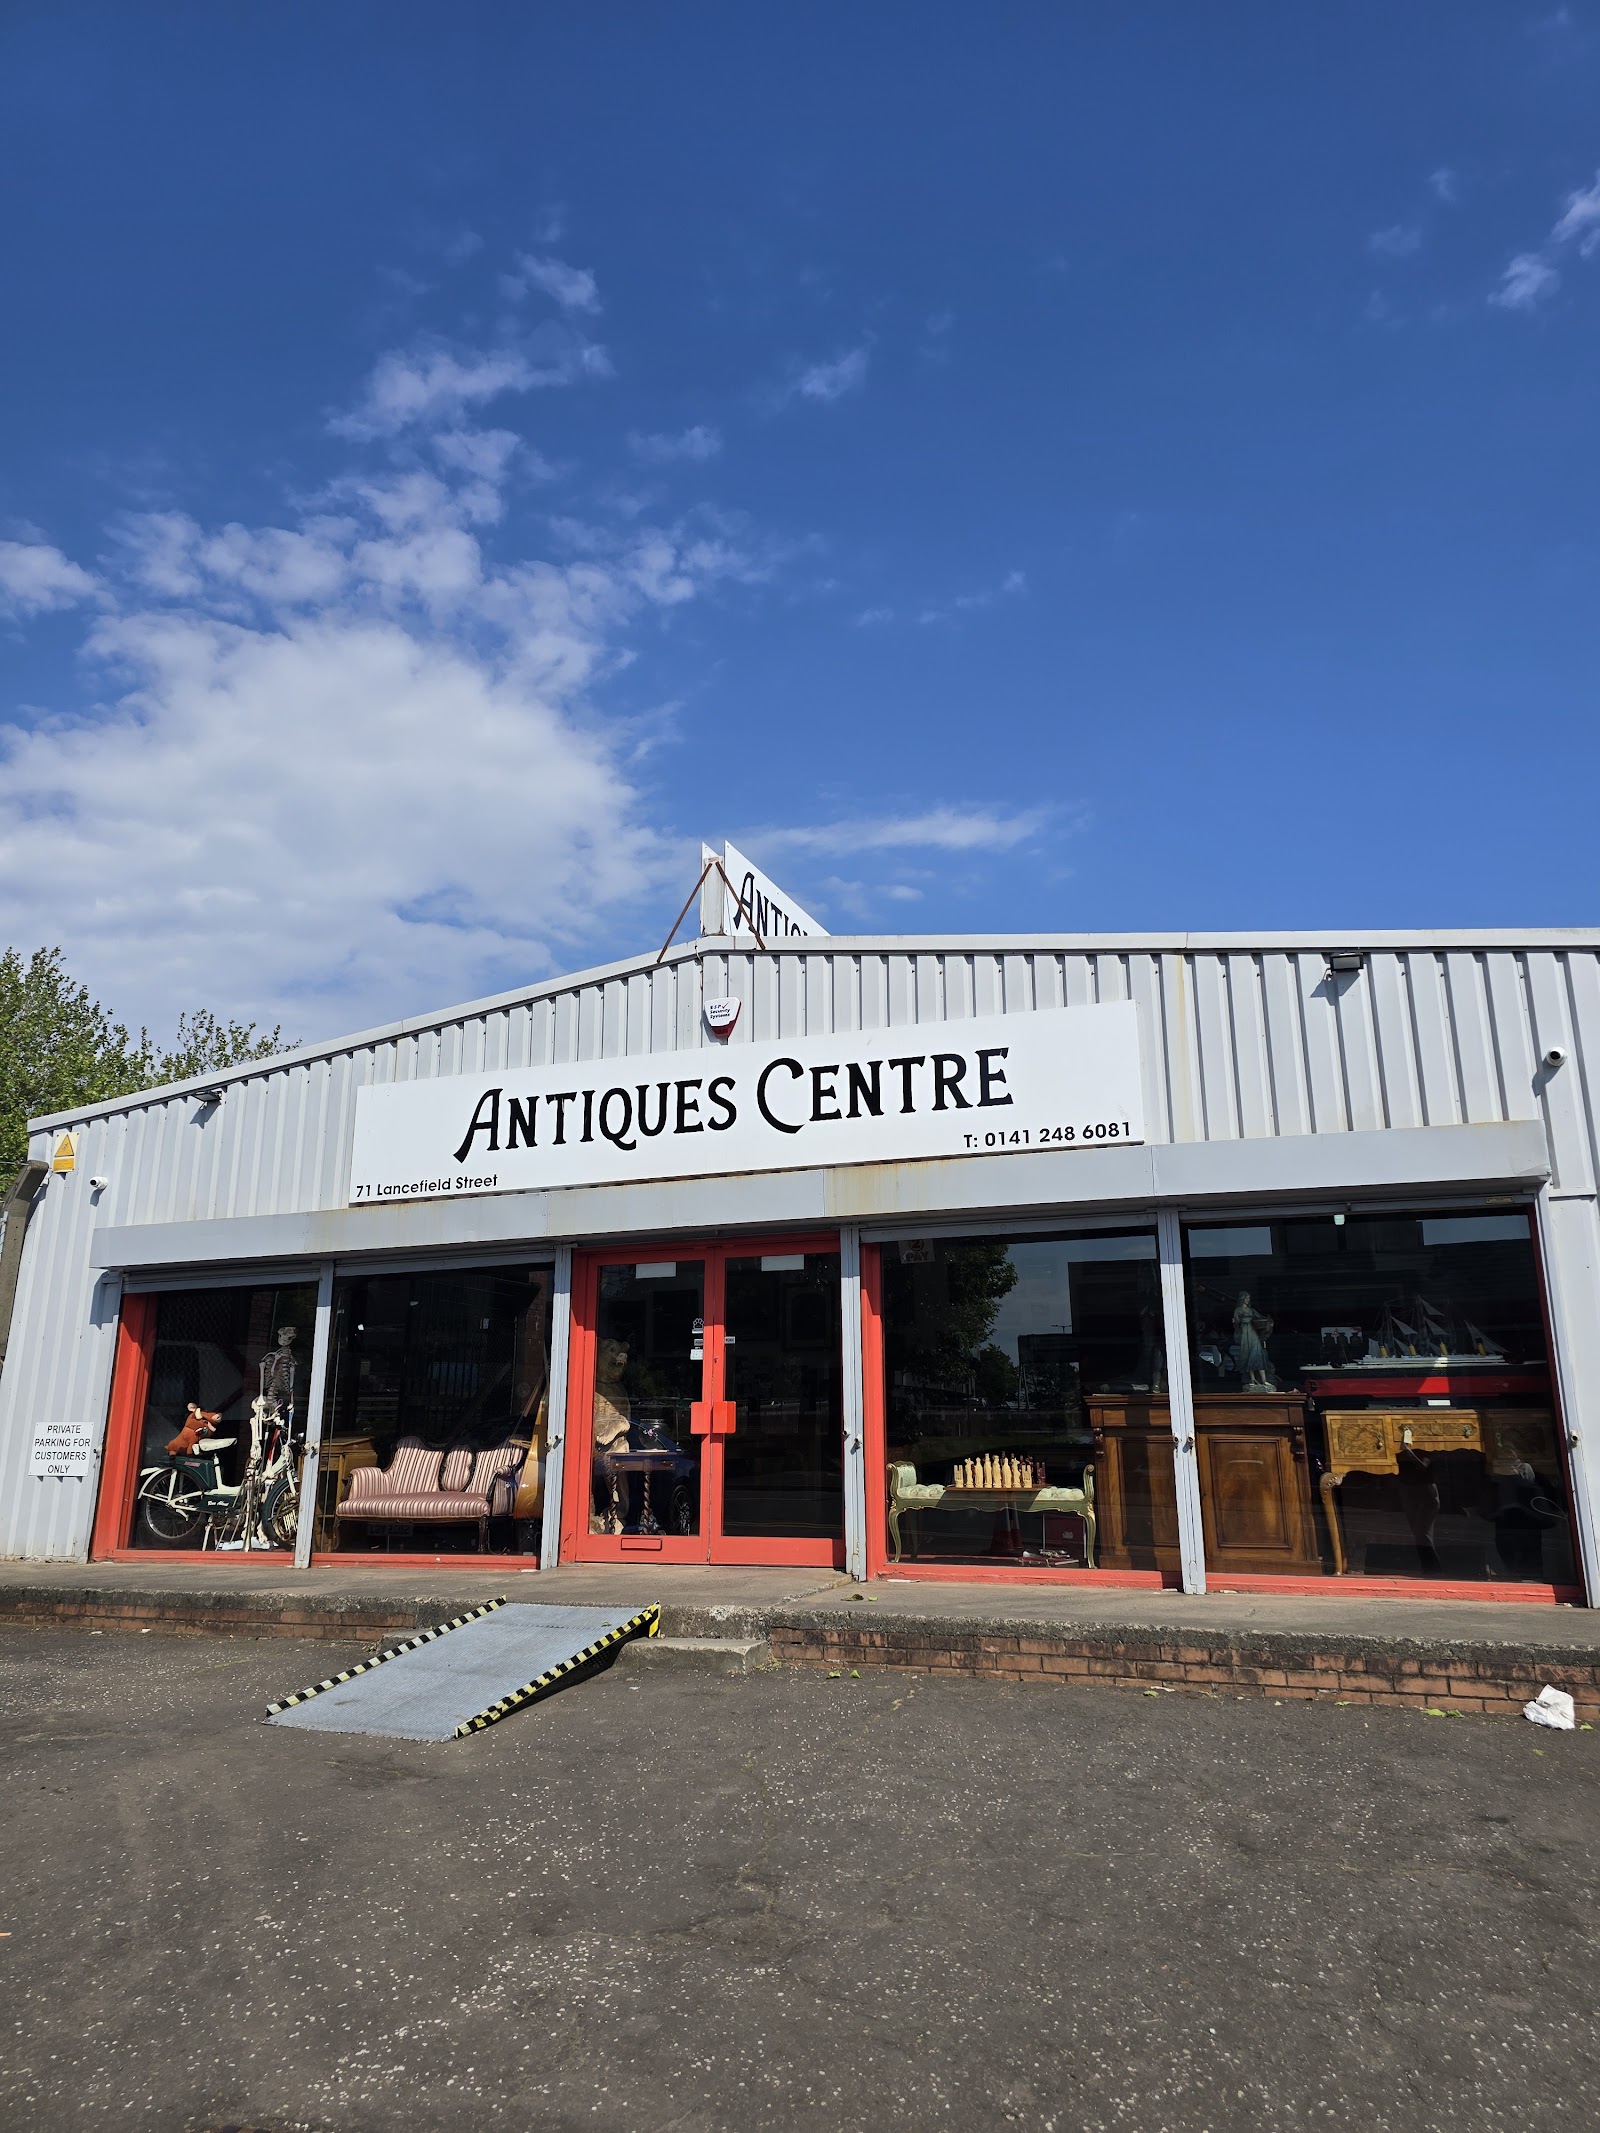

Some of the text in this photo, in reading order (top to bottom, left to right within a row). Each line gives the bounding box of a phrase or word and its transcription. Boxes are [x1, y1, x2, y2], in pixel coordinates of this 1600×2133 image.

[963, 1121, 1130, 1148] T: 0141 248 6081
[356, 1174, 498, 1198] 71 Lancefield Street
[47, 1424, 82, 1434] PRIVATE
[34, 1438, 91, 1447] PARKING FOR
[34, 1451, 87, 1461] CUSTOMERS
[47, 1464, 71, 1474] ONLY
